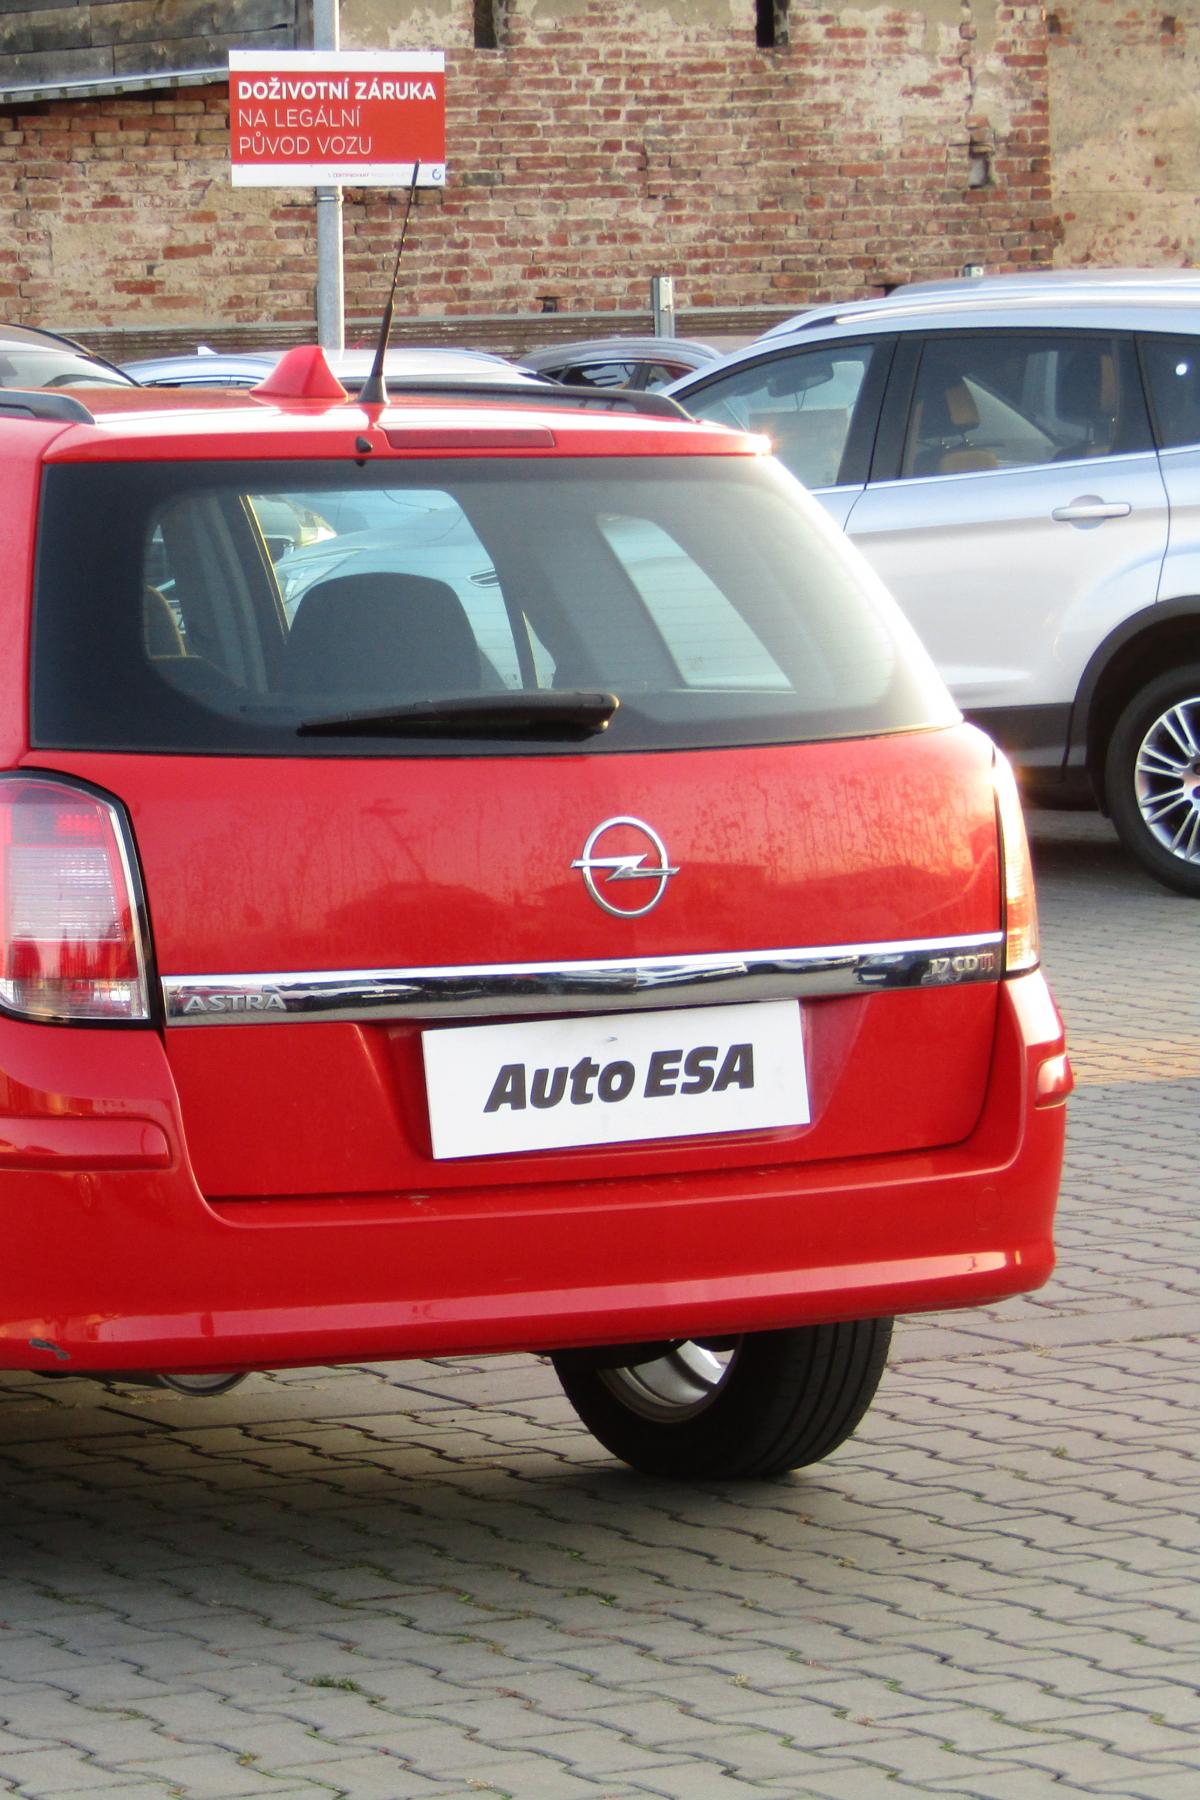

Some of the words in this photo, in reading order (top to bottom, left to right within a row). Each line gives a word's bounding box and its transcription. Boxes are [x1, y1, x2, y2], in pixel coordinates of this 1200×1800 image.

[238, 77, 349, 100] DOŽIVOTNÍ
[354, 78, 437, 100] ZÁRUKA
[239, 109, 268, 127] NA
[275, 106, 361, 127] LEGÁLNÍ
[239, 132, 310, 155] PŮVOD
[317, 136, 372, 155] VOZU
[183, 993, 288, 1014] ASTRA
[482, 1056, 635, 1113] Auto
[643, 1043, 754, 1098] ESA
